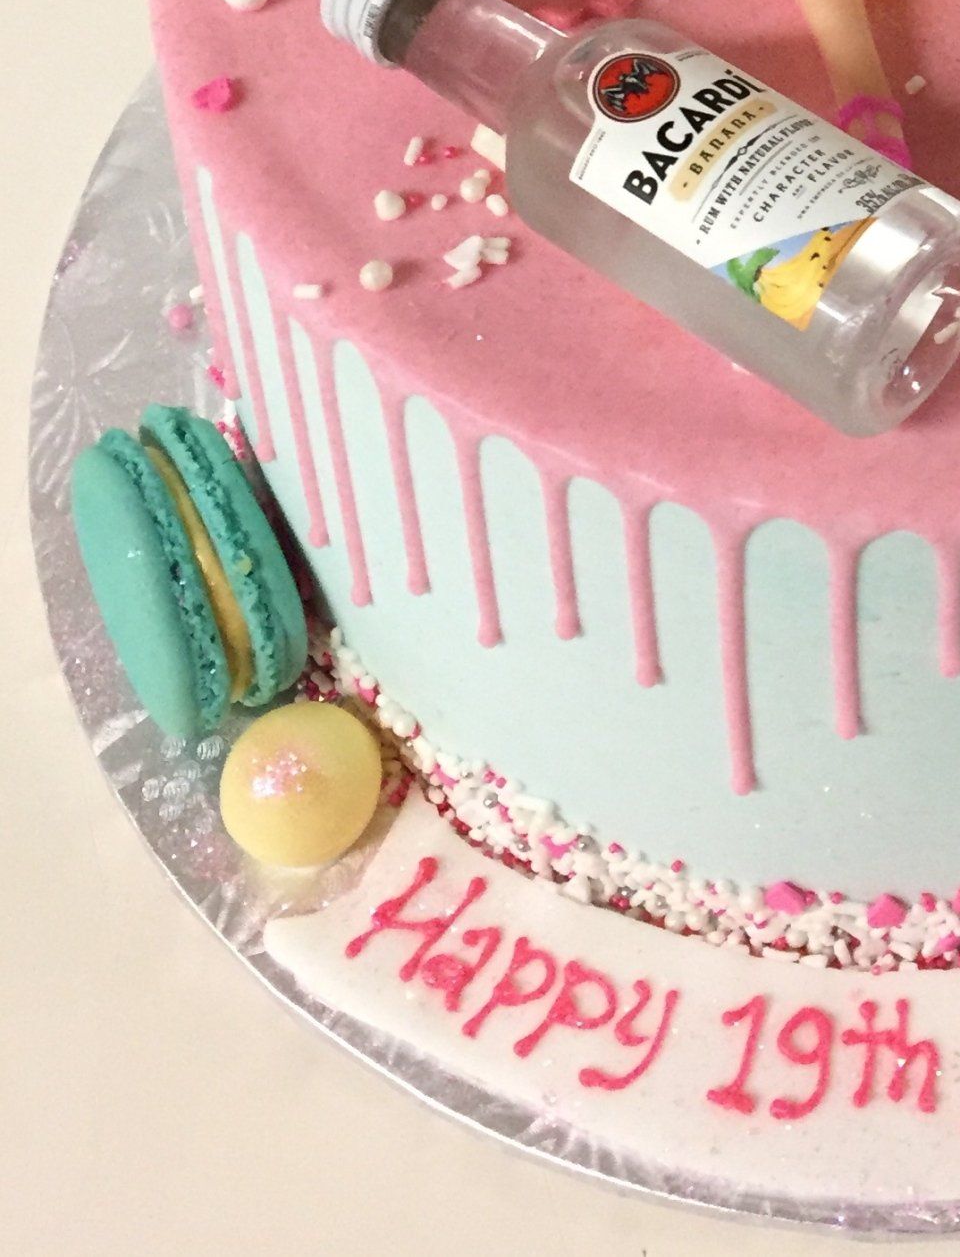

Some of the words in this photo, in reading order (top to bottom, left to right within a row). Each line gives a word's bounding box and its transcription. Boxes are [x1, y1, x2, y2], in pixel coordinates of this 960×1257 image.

[690, 110, 756, 175] BANANA
[807, 149, 854, 182] FLAVOR
[699, 207, 720, 234] RUM
[715, 176, 742, 206] WITH
[739, 135, 784, 176] NATURAL
[730, 178, 768, 229] EXPERTLY
[770, 143, 808, 176] BLENDED
[753, 149, 825, 222] CHARACTER
[855, 189, 884, 215] 35%
[345, 856, 679, 1091] Happy
[706, 993, 941, 1120] 19th
